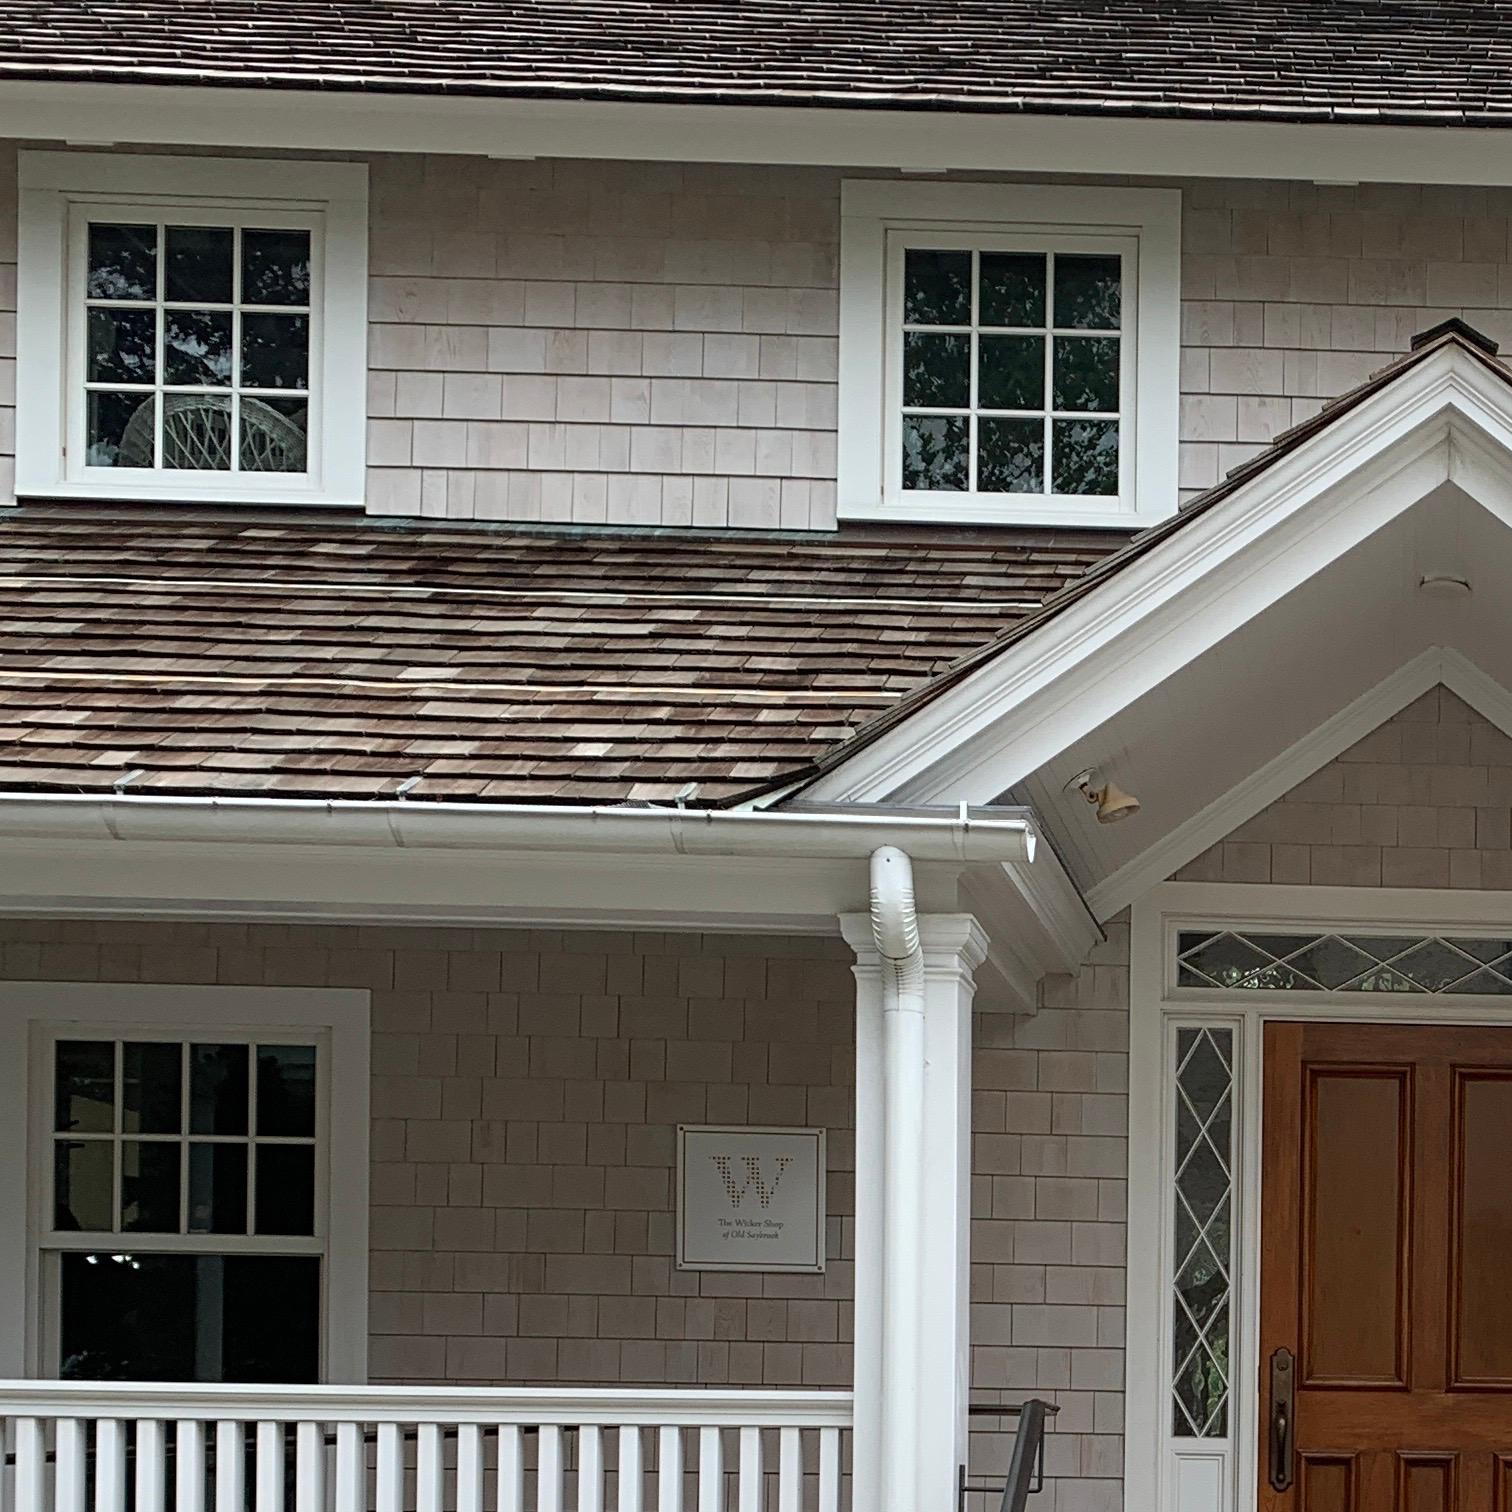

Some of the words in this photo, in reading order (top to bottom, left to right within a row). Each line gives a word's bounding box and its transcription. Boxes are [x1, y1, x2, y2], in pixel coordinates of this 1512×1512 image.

[709, 1155, 794, 1208] W
[718, 1218, 733, 1227] The
[735, 1219, 762, 1228] Wicker
[763, 1219, 784, 1230] Shop
[722, 1231, 730, 1240] of
[731, 1231, 745, 1239] Old
[746, 1231, 779, 1240] Saybrook
